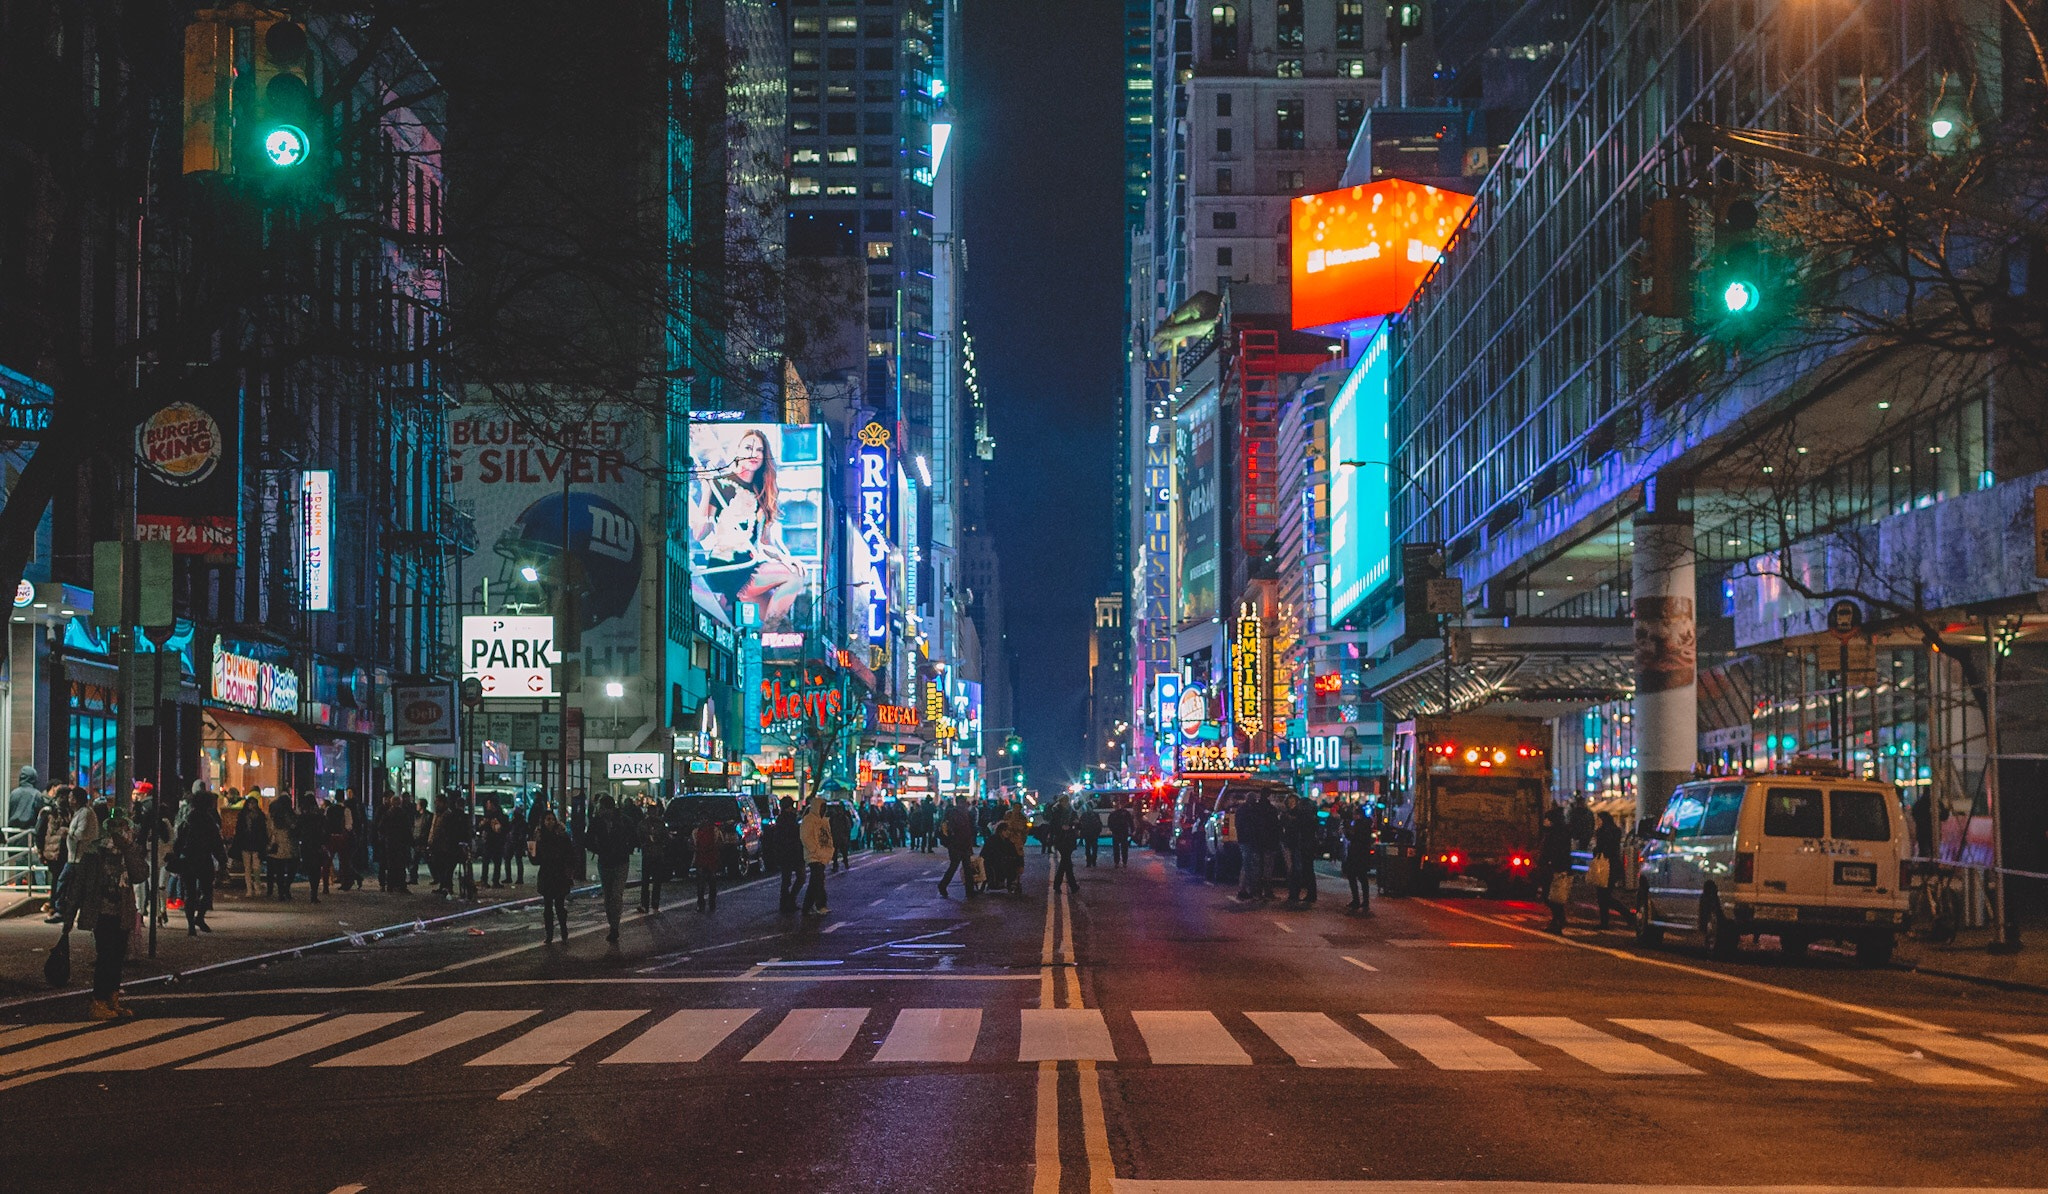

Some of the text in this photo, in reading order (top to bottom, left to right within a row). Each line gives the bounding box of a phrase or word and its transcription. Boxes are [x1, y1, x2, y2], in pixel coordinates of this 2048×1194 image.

[146, 418, 210, 445] BURGER
[149, 431, 211, 463] KING
[479, 449, 625, 484] SILVER
[136, 524, 172, 541] PEN
[175, 525, 198, 544] 24
[860, 454, 888, 637] REGAL
[1147, 513, 1167, 673] TUSSAUD
[471, 638, 551, 669] PARK
[1242, 621, 1257, 716] EMPIRE
[225, 679, 258, 709] DONUTS
[877, 704, 919, 726] REGAL
[613, 763, 654, 774] PARK
